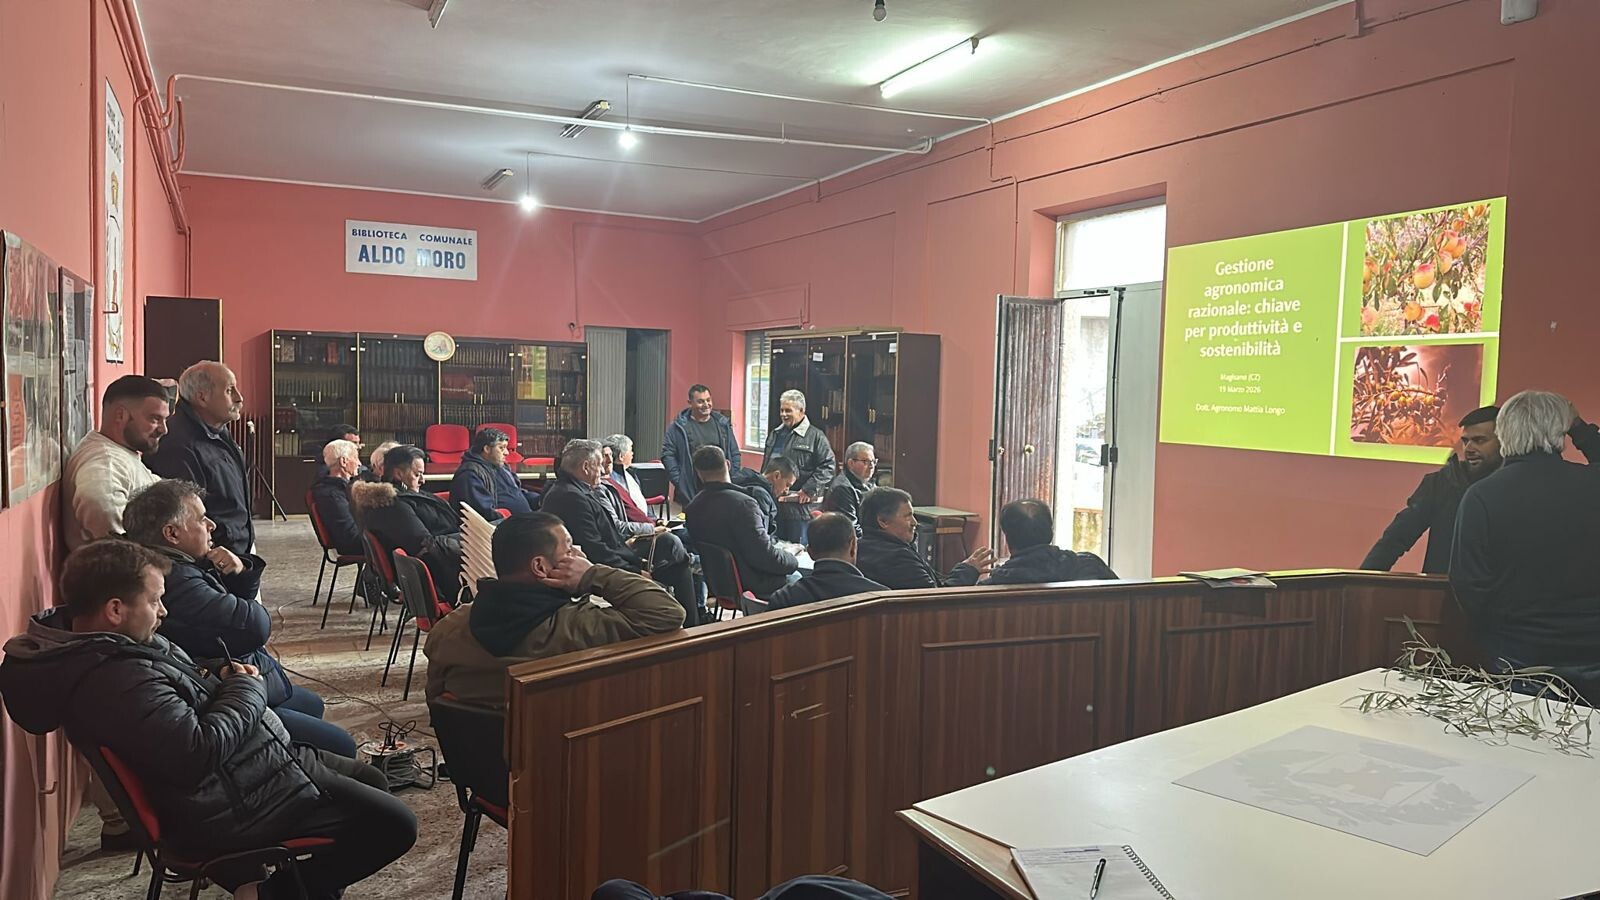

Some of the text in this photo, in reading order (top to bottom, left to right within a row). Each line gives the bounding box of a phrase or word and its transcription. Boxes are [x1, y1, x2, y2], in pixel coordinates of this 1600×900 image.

[351, 228, 473, 246] BIBLIOTECA COMUNALE
[358, 244, 466, 269] ALDO MORO
[1215, 258, 1274, 276] Gestione
[1204, 277, 1284, 300] agronomica
[1188, 298, 1301, 318] razionale: chiave
[1184, 318, 1302, 343] per produttività e
[1200, 340, 1281, 358] sostenibilità
[1227, 385, 1245, 393] Marzo
[1211, 403, 1242, 414] Agronomo
[1243, 404, 1264, 414] Mattia
[1265, 404, 1286, 417] Longo
